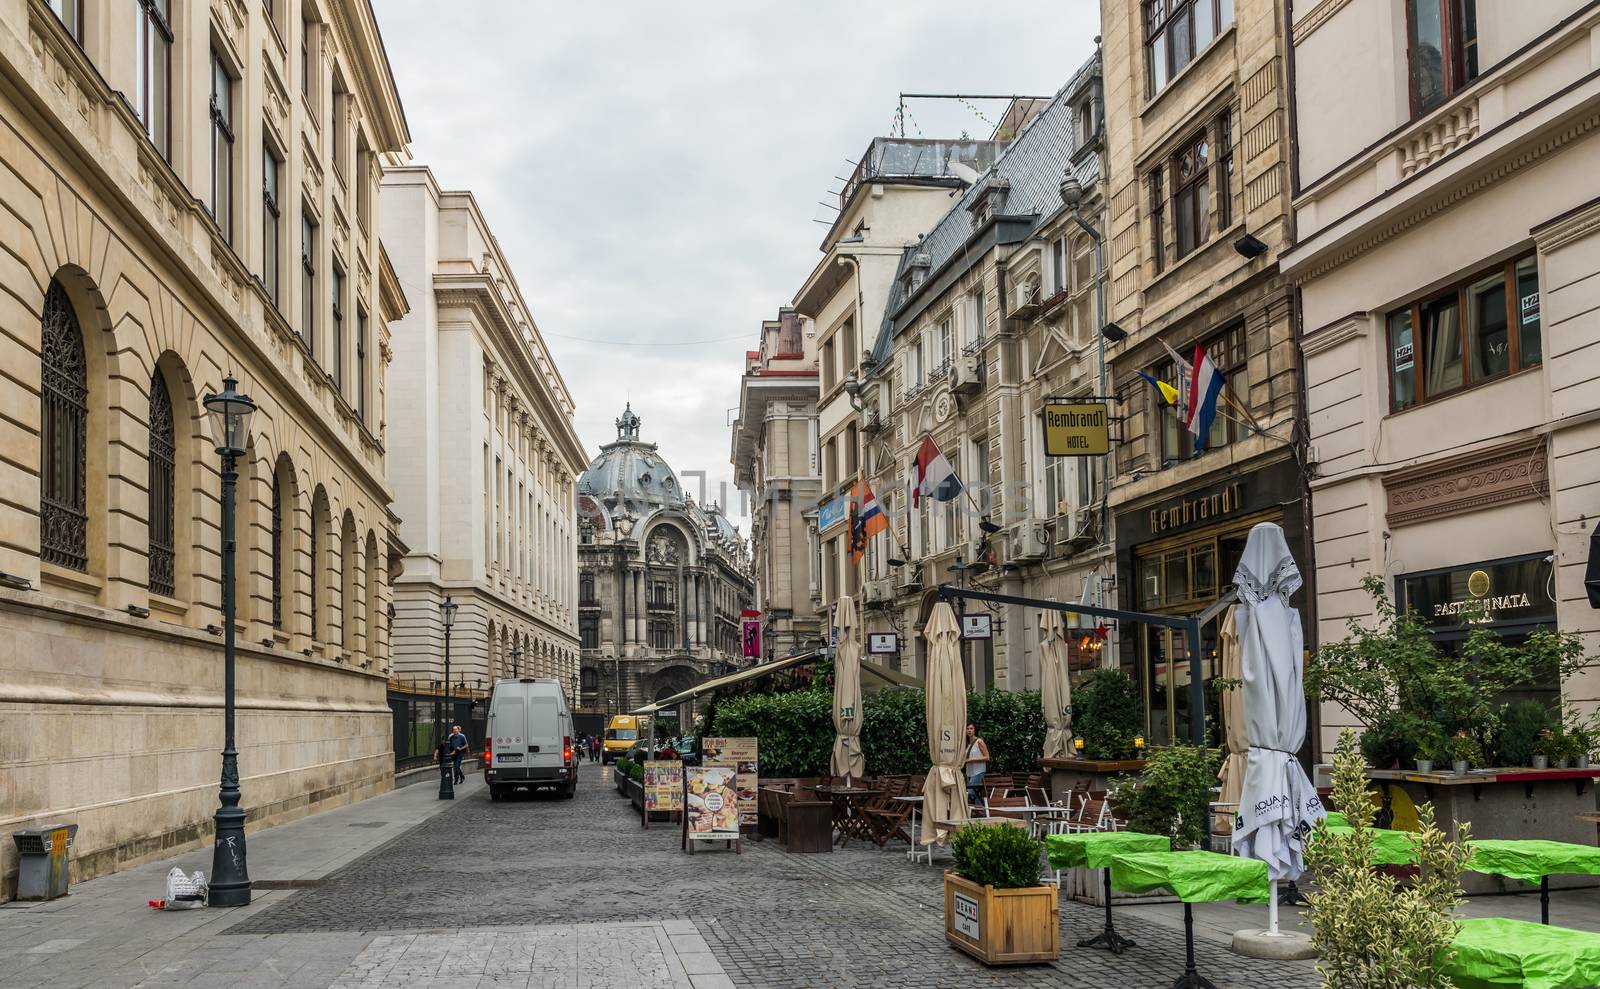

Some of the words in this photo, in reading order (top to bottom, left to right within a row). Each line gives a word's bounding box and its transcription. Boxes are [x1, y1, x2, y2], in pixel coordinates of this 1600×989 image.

[1396, 345, 1412, 358] H2H
[1066, 436, 1090, 449] HOTEL
[1492, 593, 1531, 610] NATA
[1255, 795, 1281, 813] AQUA
